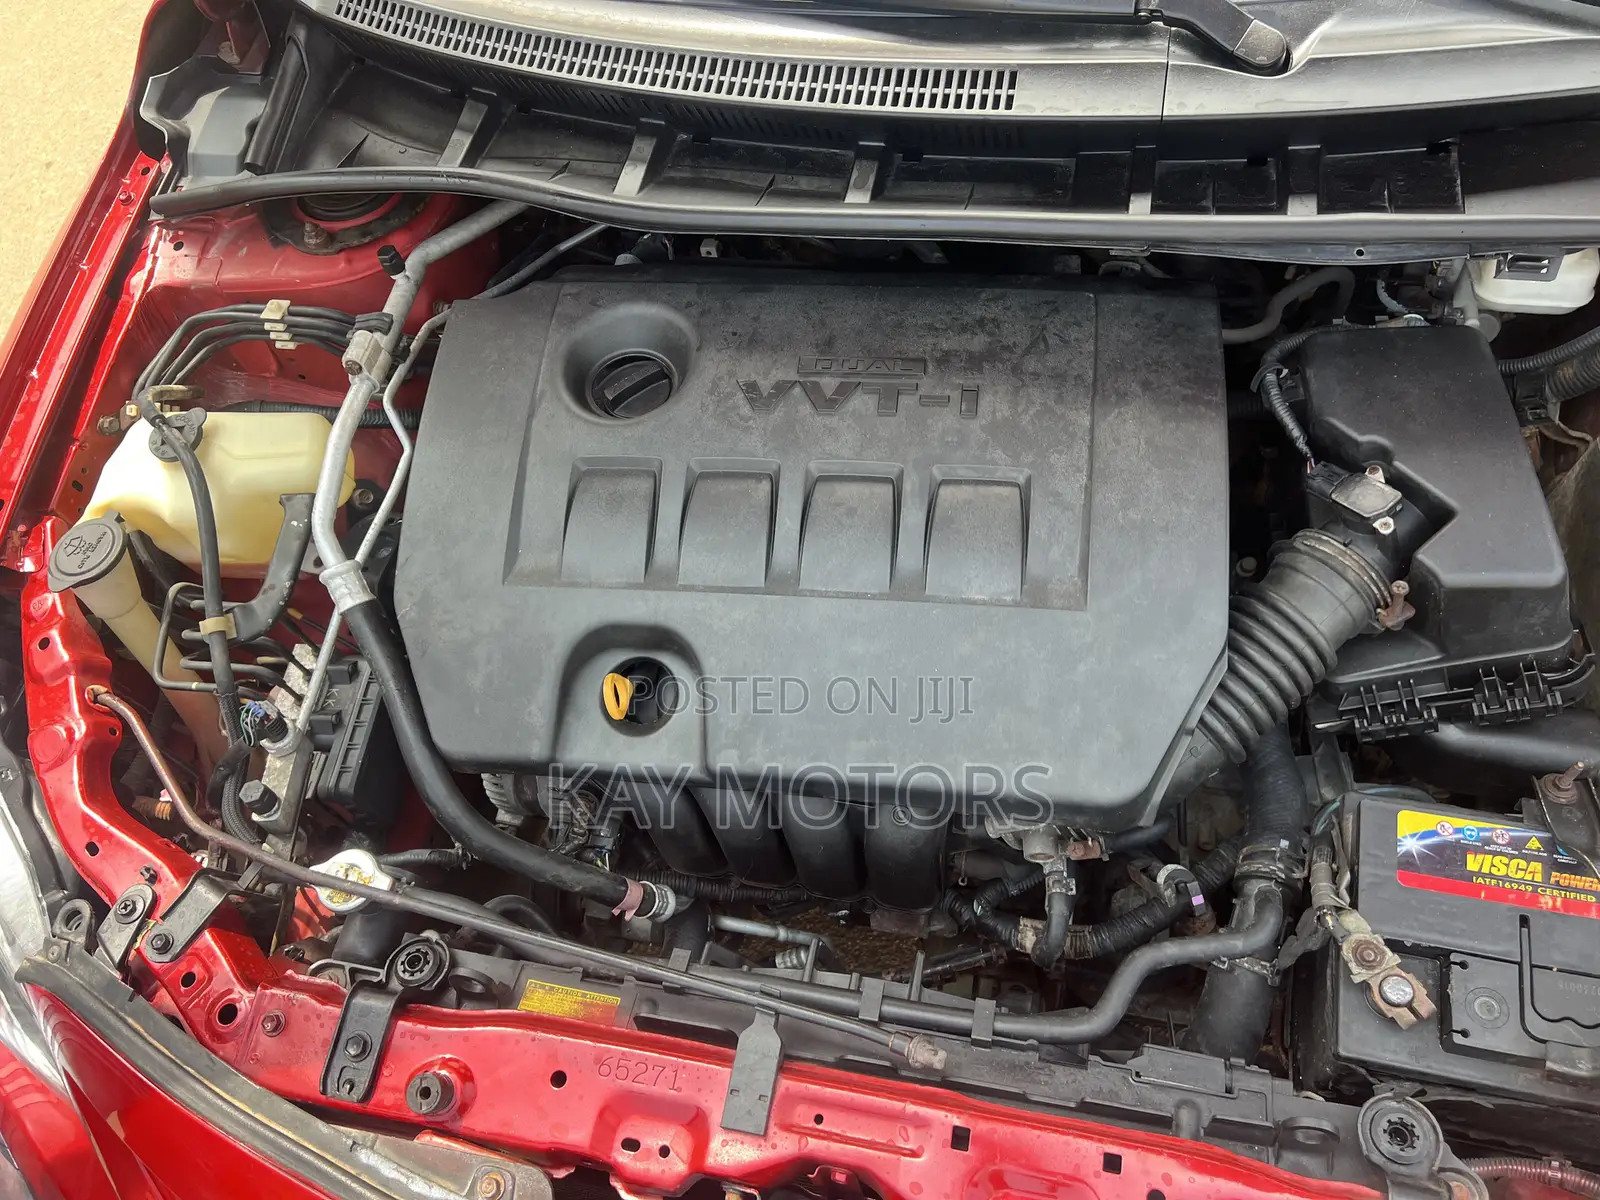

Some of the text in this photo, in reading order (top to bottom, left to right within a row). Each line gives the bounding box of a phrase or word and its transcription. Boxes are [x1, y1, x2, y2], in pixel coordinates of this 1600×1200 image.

[813, 357, 915, 372] DUAL
[1466, 851, 1543, 882] VISCA
[1472, 875, 1596, 903] IATF16949 CERTIFIED
[598, 1056, 681, 1093] 65271
